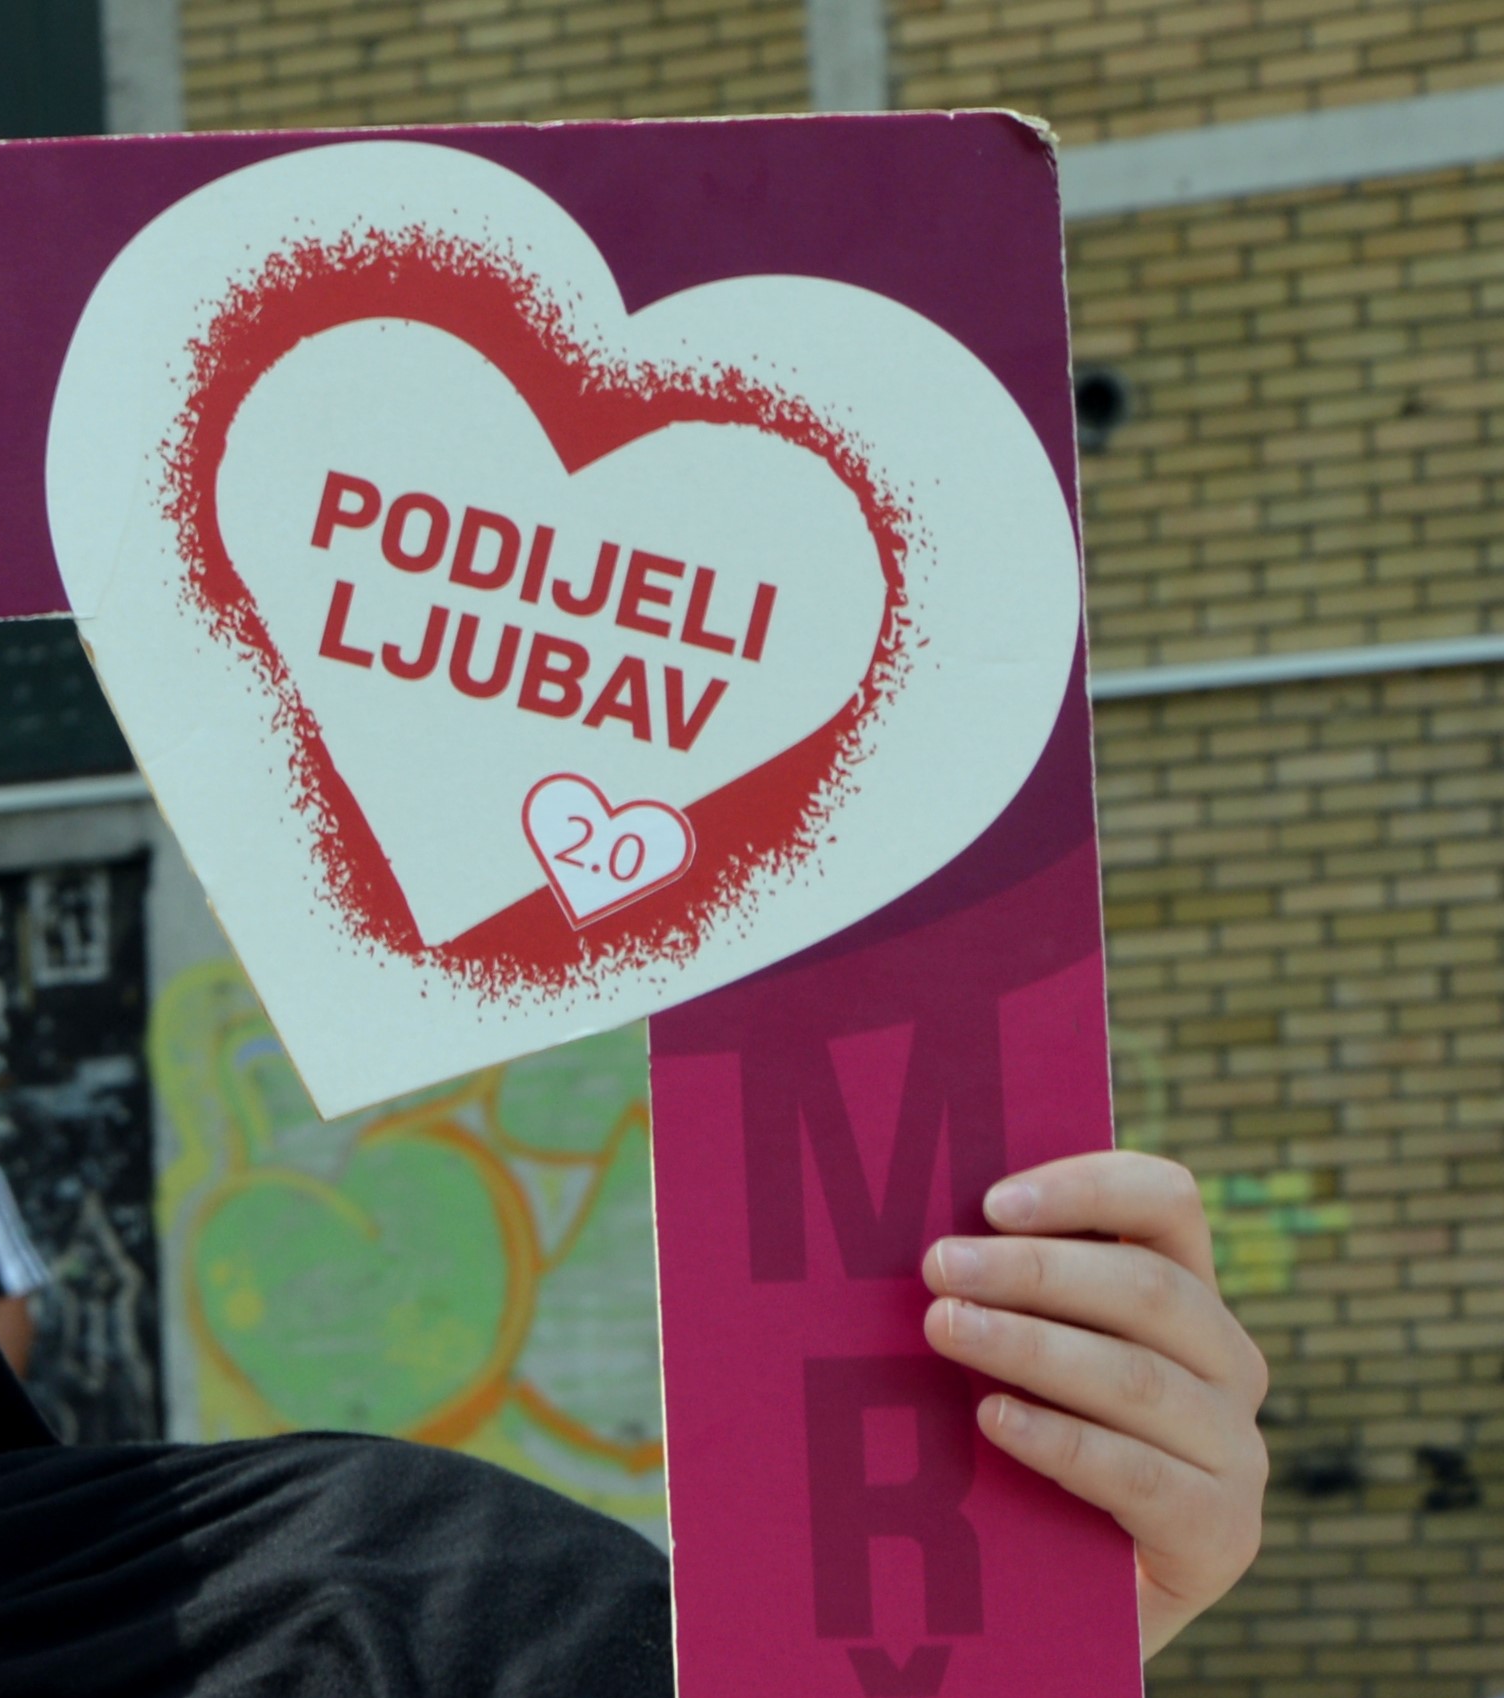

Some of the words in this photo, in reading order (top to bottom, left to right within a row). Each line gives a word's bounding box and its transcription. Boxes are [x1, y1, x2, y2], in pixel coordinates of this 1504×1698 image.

[310, 470, 778, 663] PODIJELI
[317, 580, 729, 753] LJUBAV
[553, 815, 646, 881] 2.0
